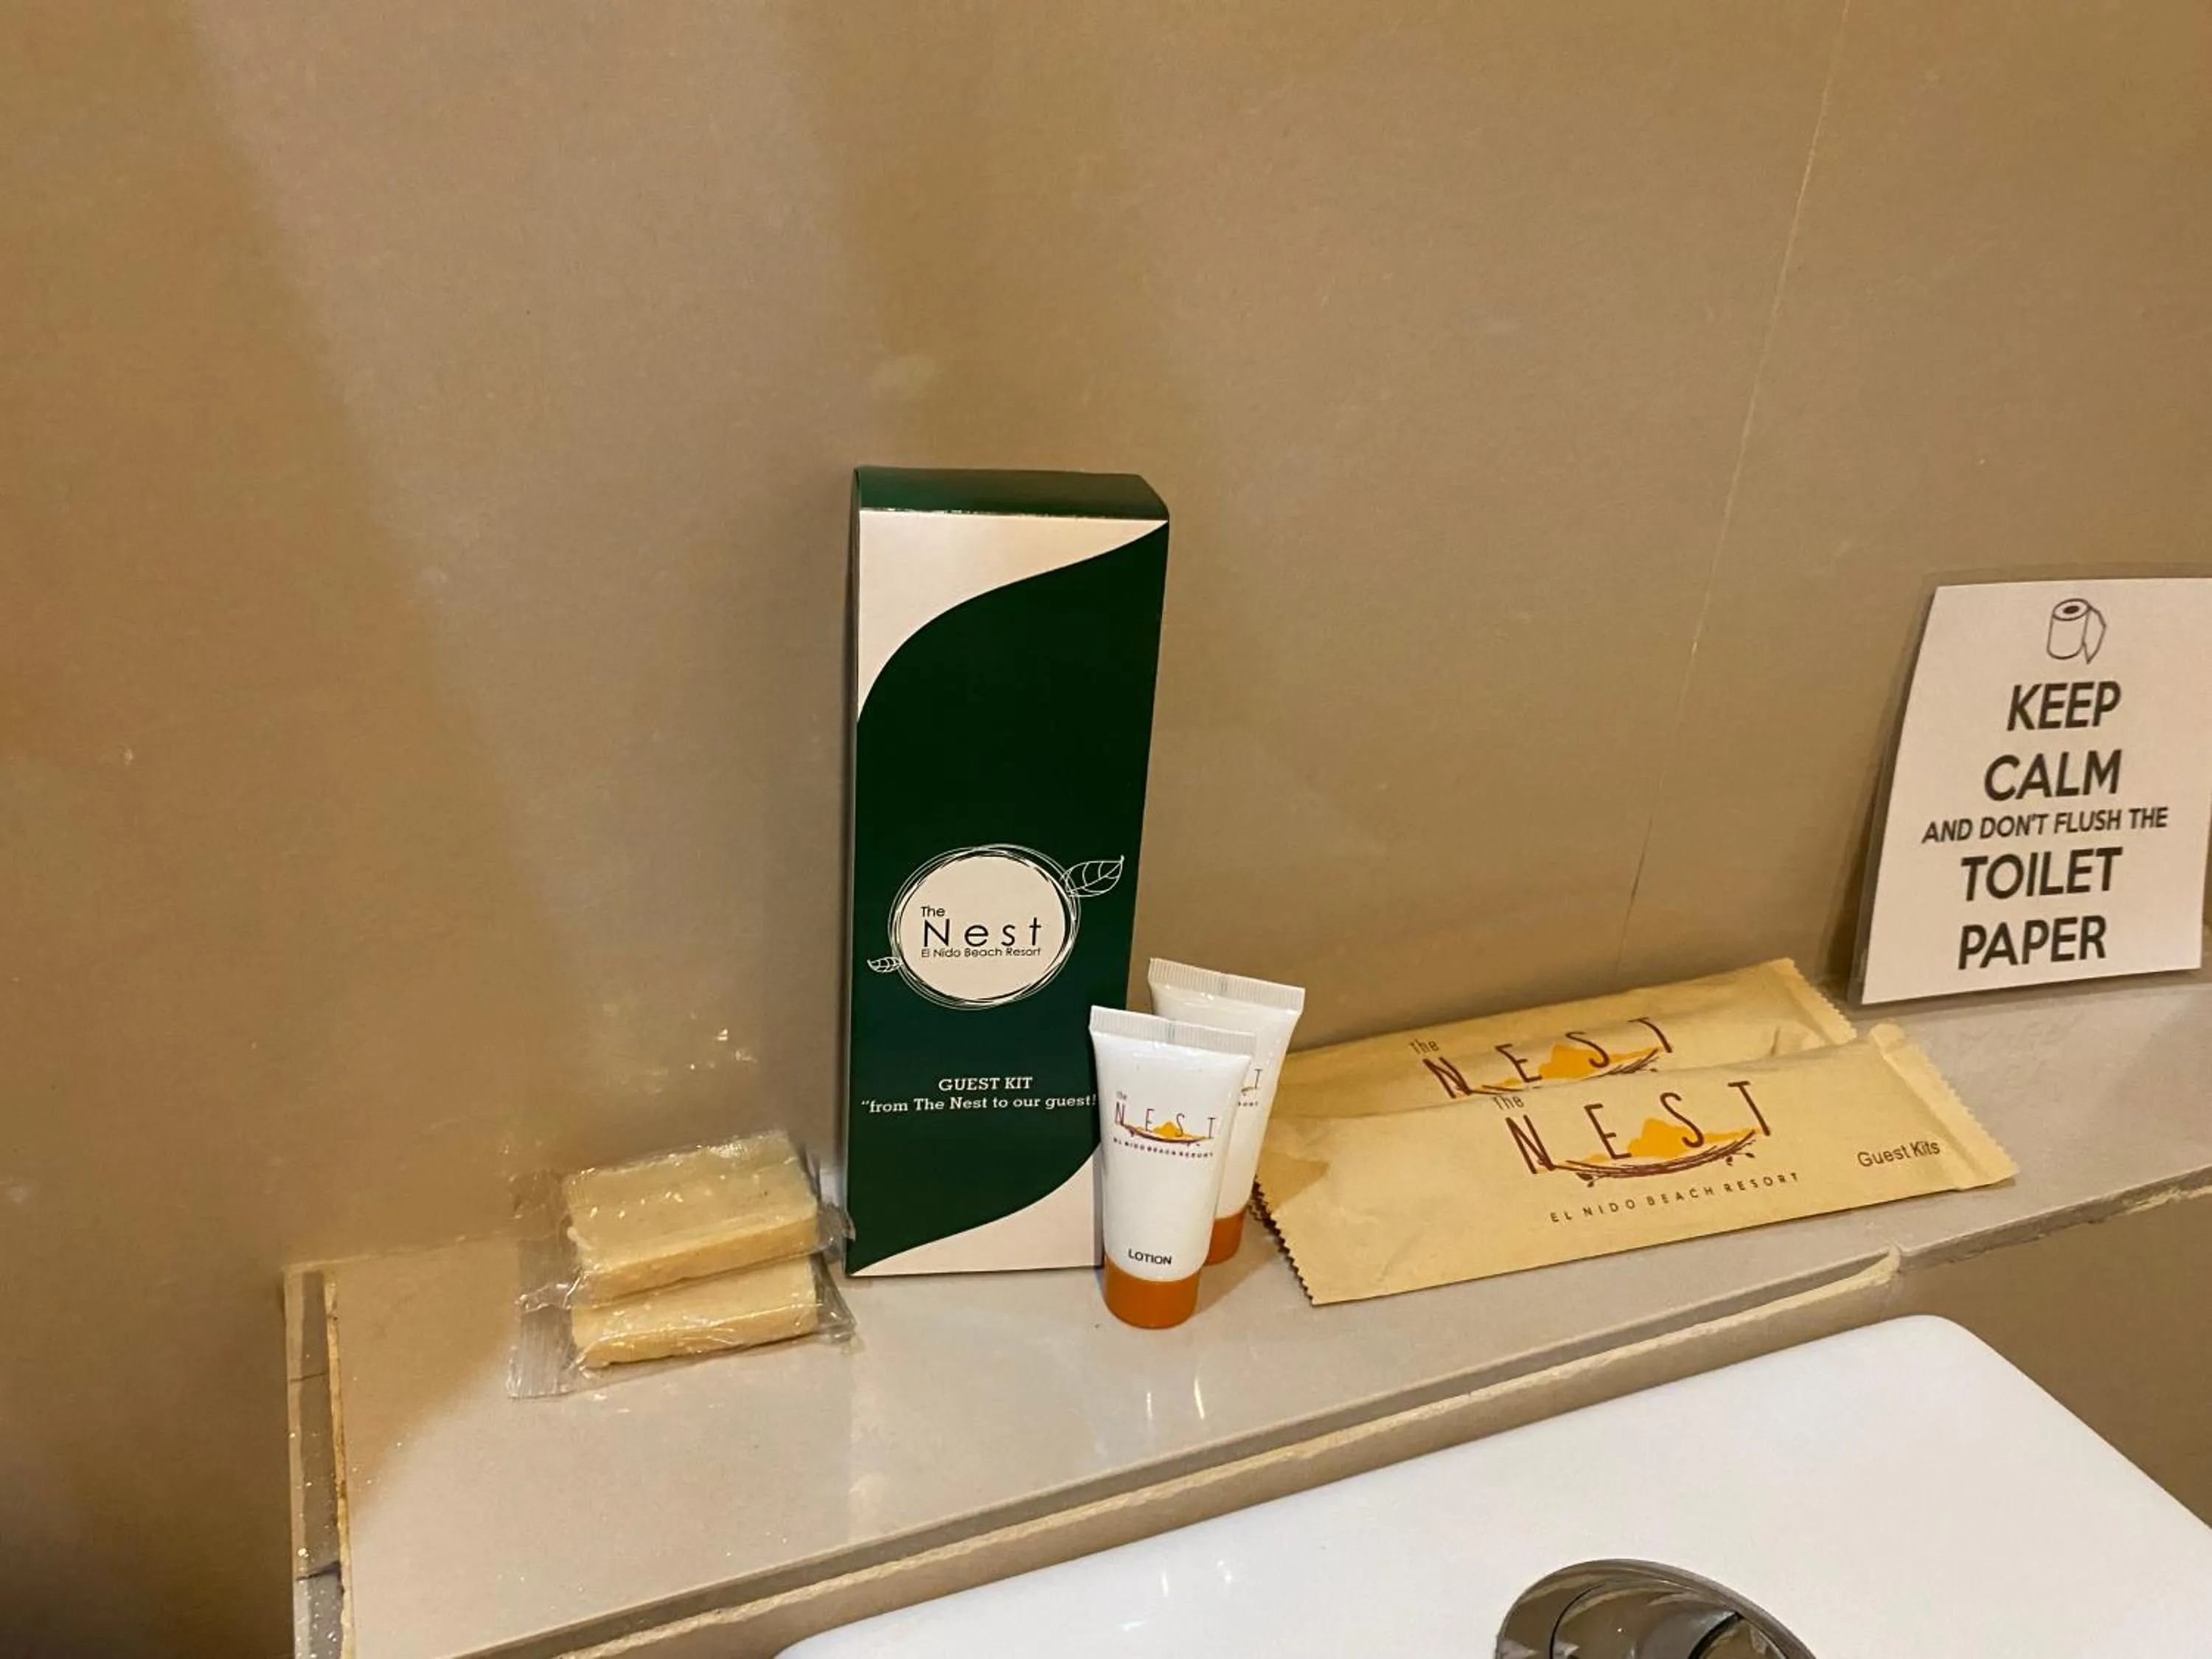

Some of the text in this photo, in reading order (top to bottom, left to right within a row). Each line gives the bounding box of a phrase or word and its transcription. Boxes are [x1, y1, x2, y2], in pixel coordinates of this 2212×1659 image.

[2007, 681, 2122, 731] KEEP
[1984, 748, 2122, 801] CALM
[1921, 806, 2168, 844] AND DON'T FLUSH THE
[1960, 846, 2124, 902] TOILET
[921, 905, 946, 917] The
[924, 917, 1042, 947] Nest
[1958, 914, 2107, 970] PAPER
[921, 947, 1041, 958] El Nido Beach Resort
[1410, 1038, 1440, 1055] The
[1423, 1017, 1673, 1099] NEST
[938, 1076, 1033, 1091] GUEST KIT
[914, 1097, 945, 1111] The
[949, 1096, 987, 1110] Nest
[992, 1096, 1009, 1108] to
[1012, 1097, 1040, 1107] our
[1492, 1093, 1526, 1111] The
[1114, 1101, 1217, 1139] NEST
[1506, 1080, 1771, 1175] NEST
[1857, 1141, 1941, 1167] Guest Kits
[1550, 1171, 1800, 1224] EL NIDO BEACH RESORT
[1127, 1248, 1172, 1265] LOTION
